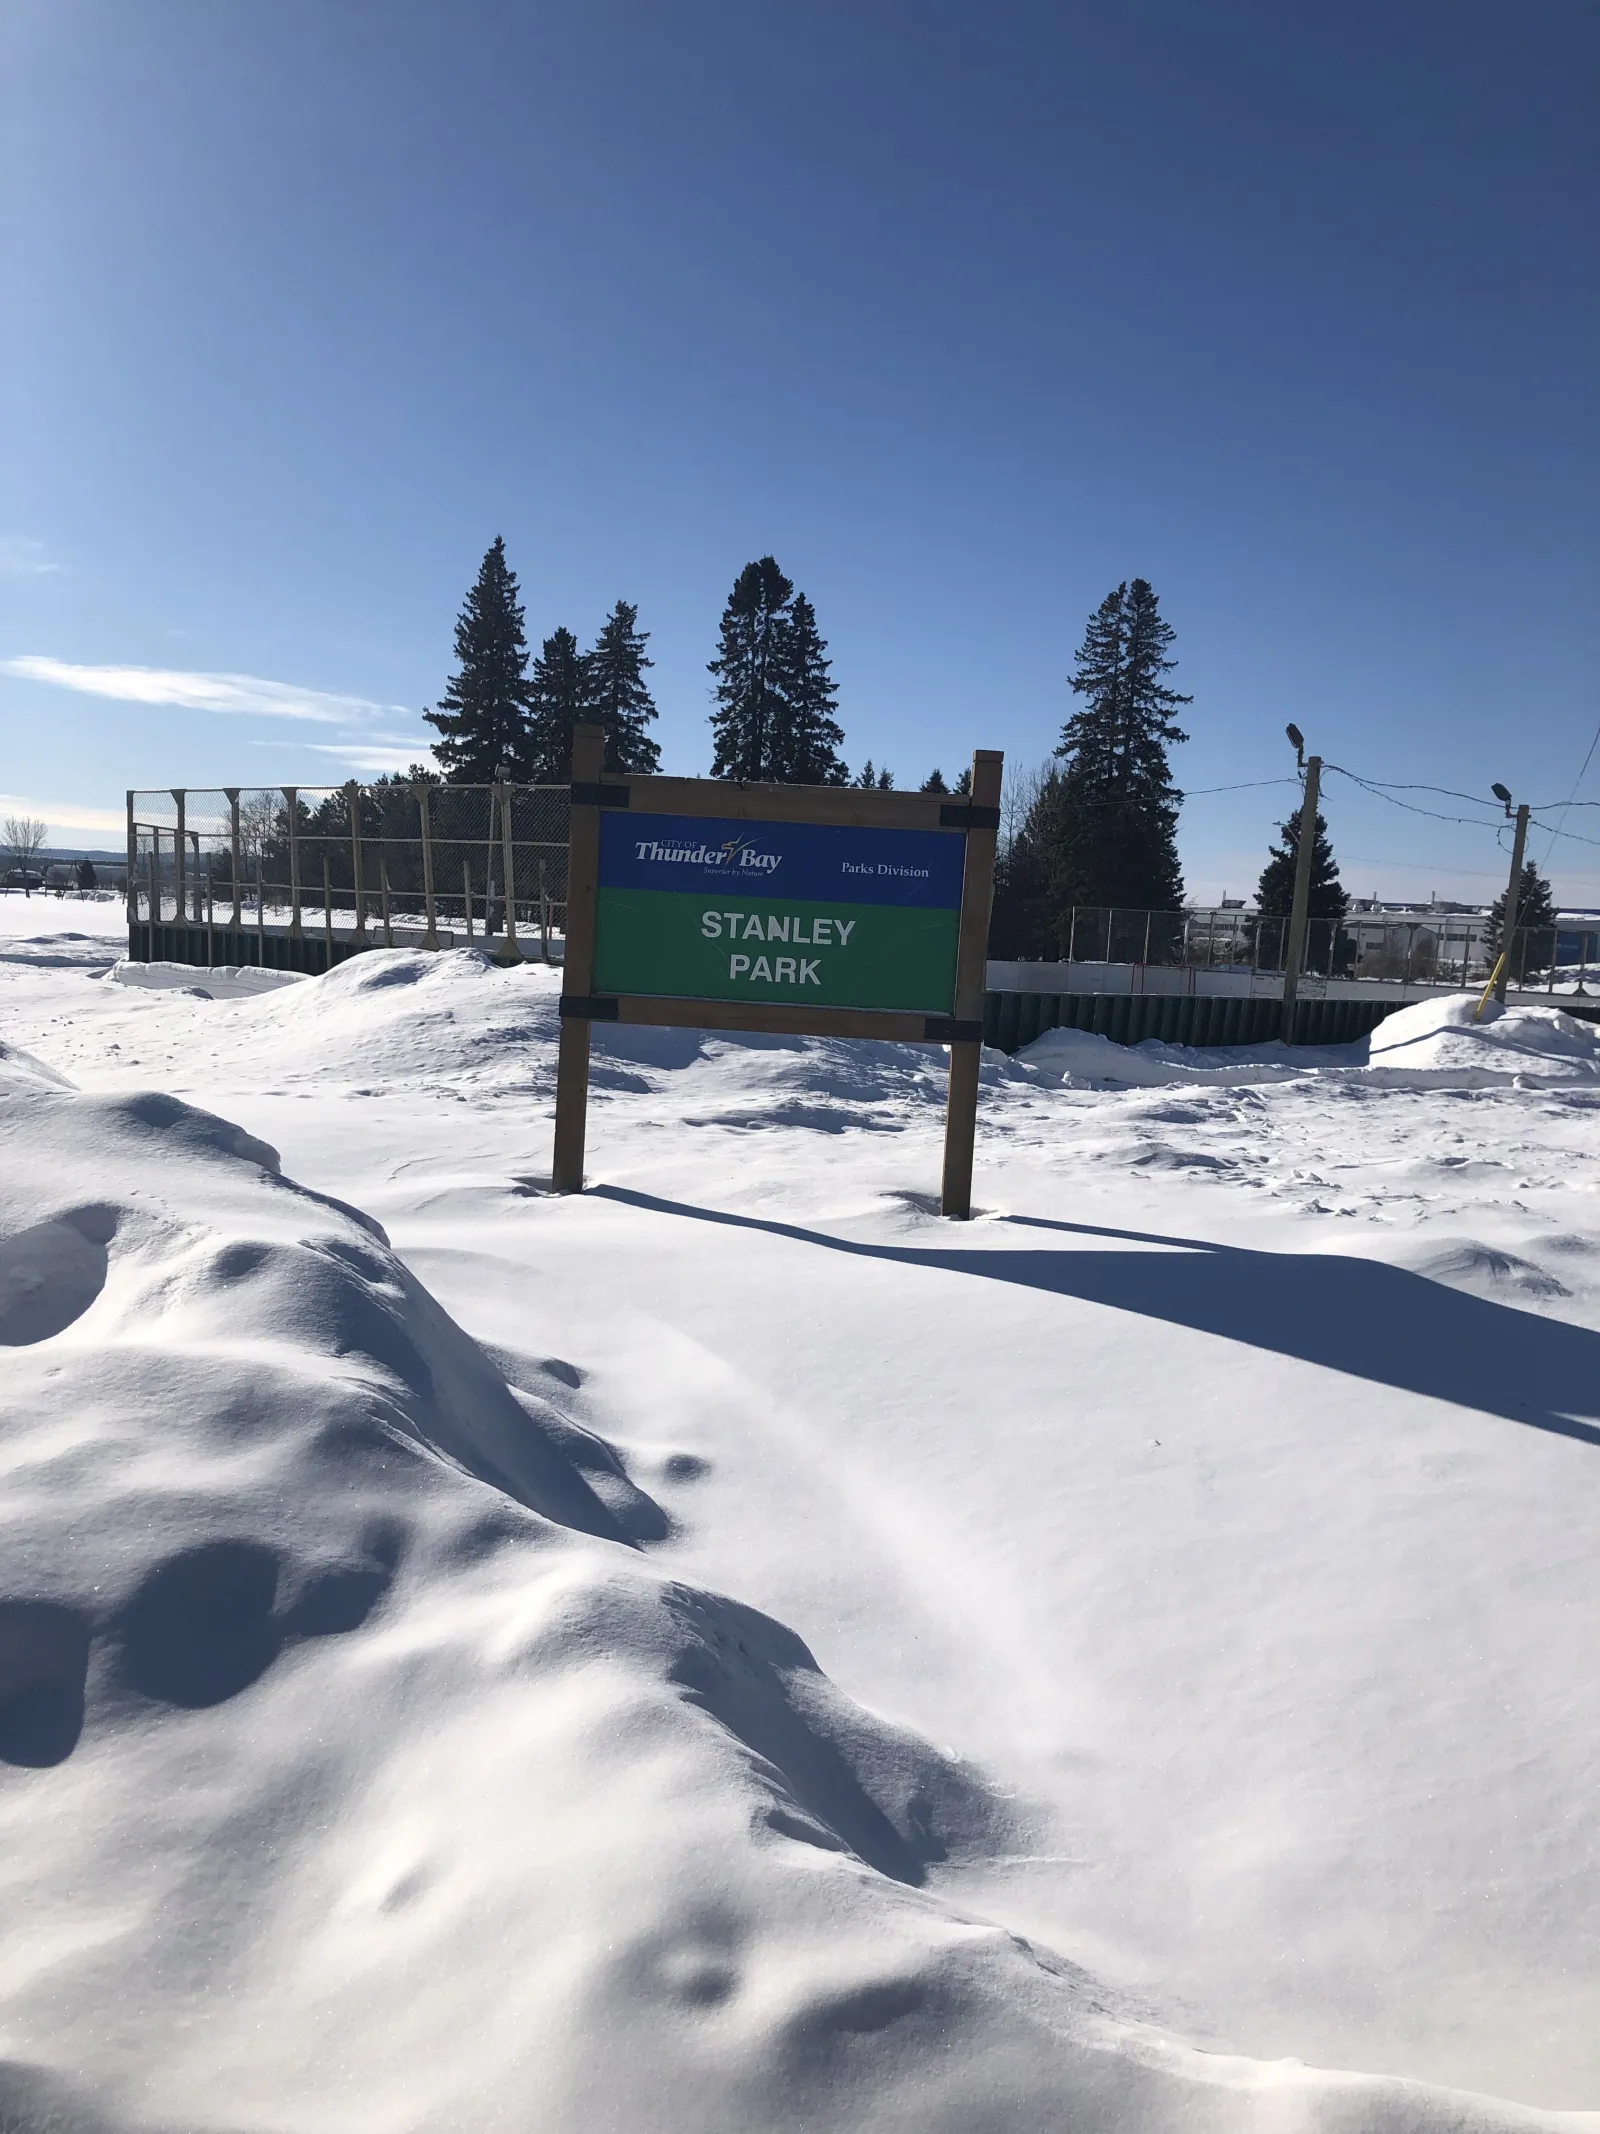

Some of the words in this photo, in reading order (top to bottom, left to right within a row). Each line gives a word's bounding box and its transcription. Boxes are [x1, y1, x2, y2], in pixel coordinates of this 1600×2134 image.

[661, 840, 682, 849] CITY
[684, 841, 697, 849] OF
[635, 842, 727, 864] Thunder
[739, 849, 782, 874] Bay
[841, 862, 874, 874] Parks
[877, 864, 929, 877] Division
[703, 866, 731, 875] Superior
[701, 911, 856, 946] STANLEY
[729, 954, 822, 985] PARK
